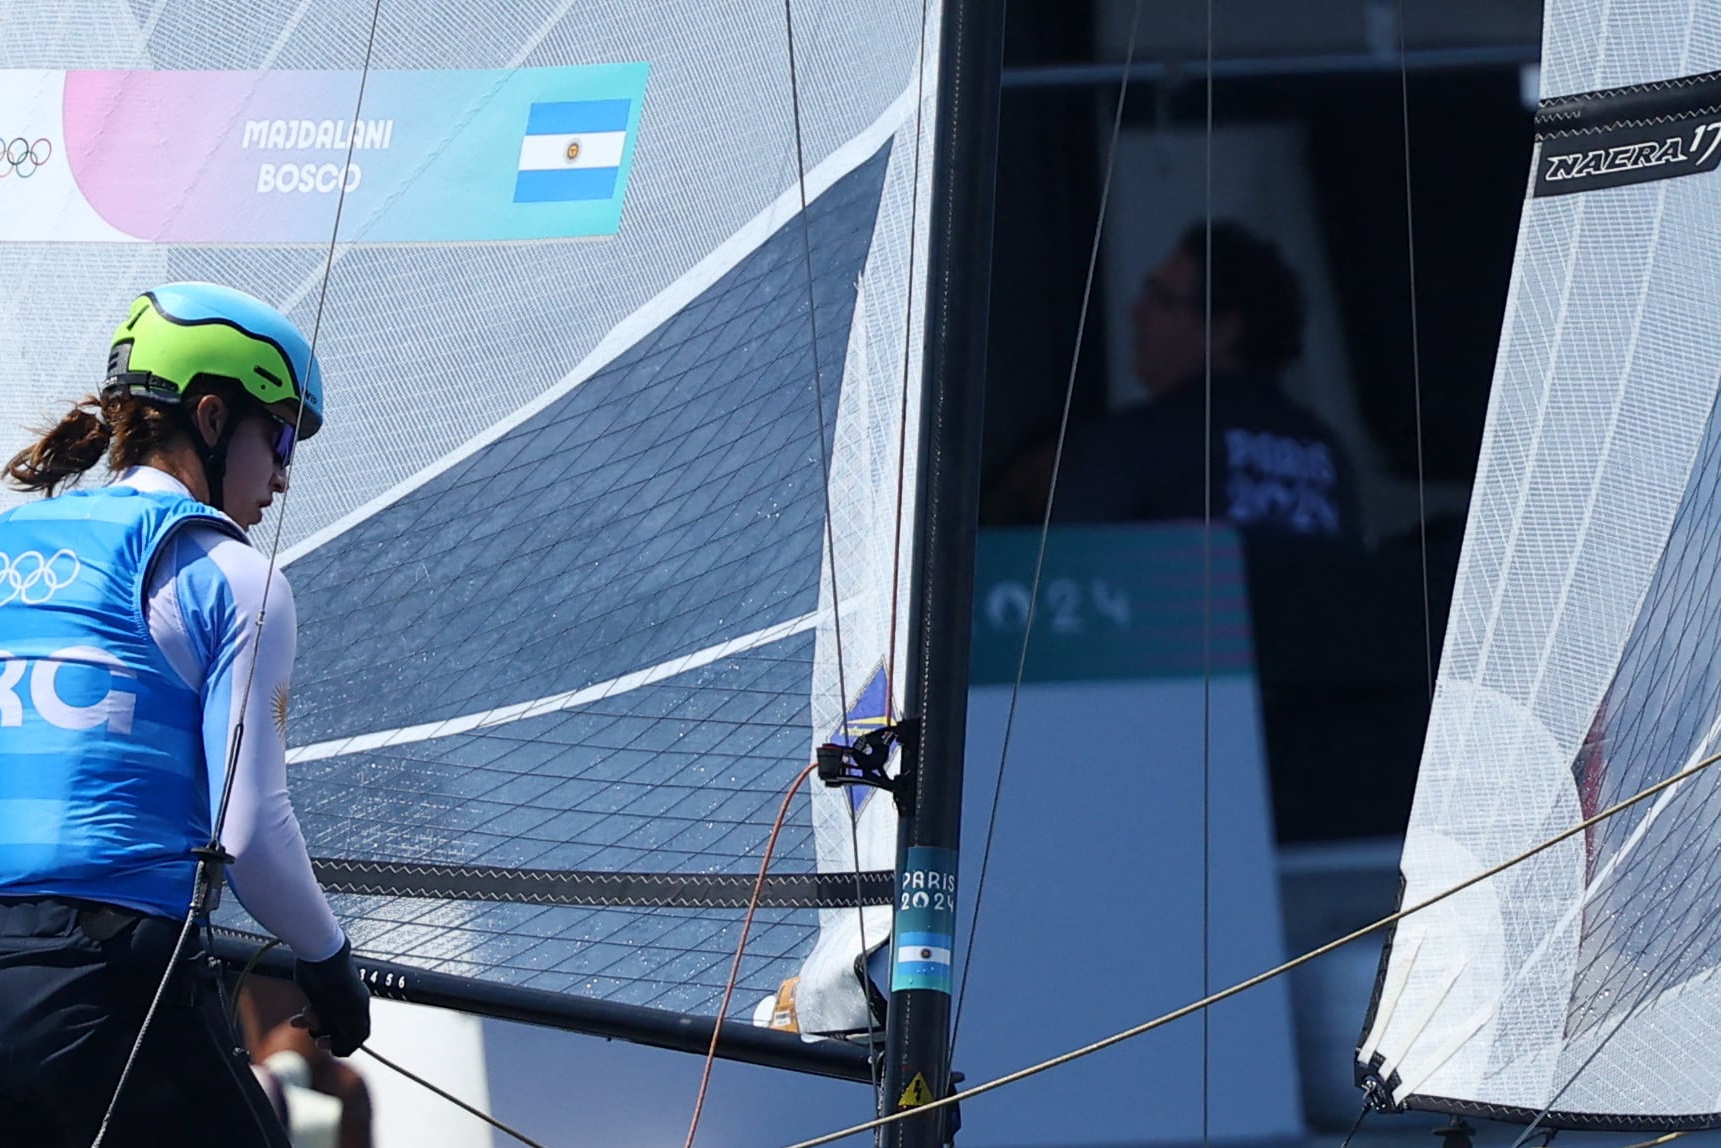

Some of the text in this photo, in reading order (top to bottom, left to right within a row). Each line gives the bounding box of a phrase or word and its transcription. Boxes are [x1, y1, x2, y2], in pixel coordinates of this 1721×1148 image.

[241, 119, 394, 150] MAJDALANI
[1689, 122, 1721, 166] 17
[256, 163, 363, 193] BOSCO
[980, 577, 1132, 634] 024
[901, 891, 955, 914] 2024
[370, 970, 378, 984] 4
[385, 973, 394, 987] 5
[398, 975, 406, 989] 6
